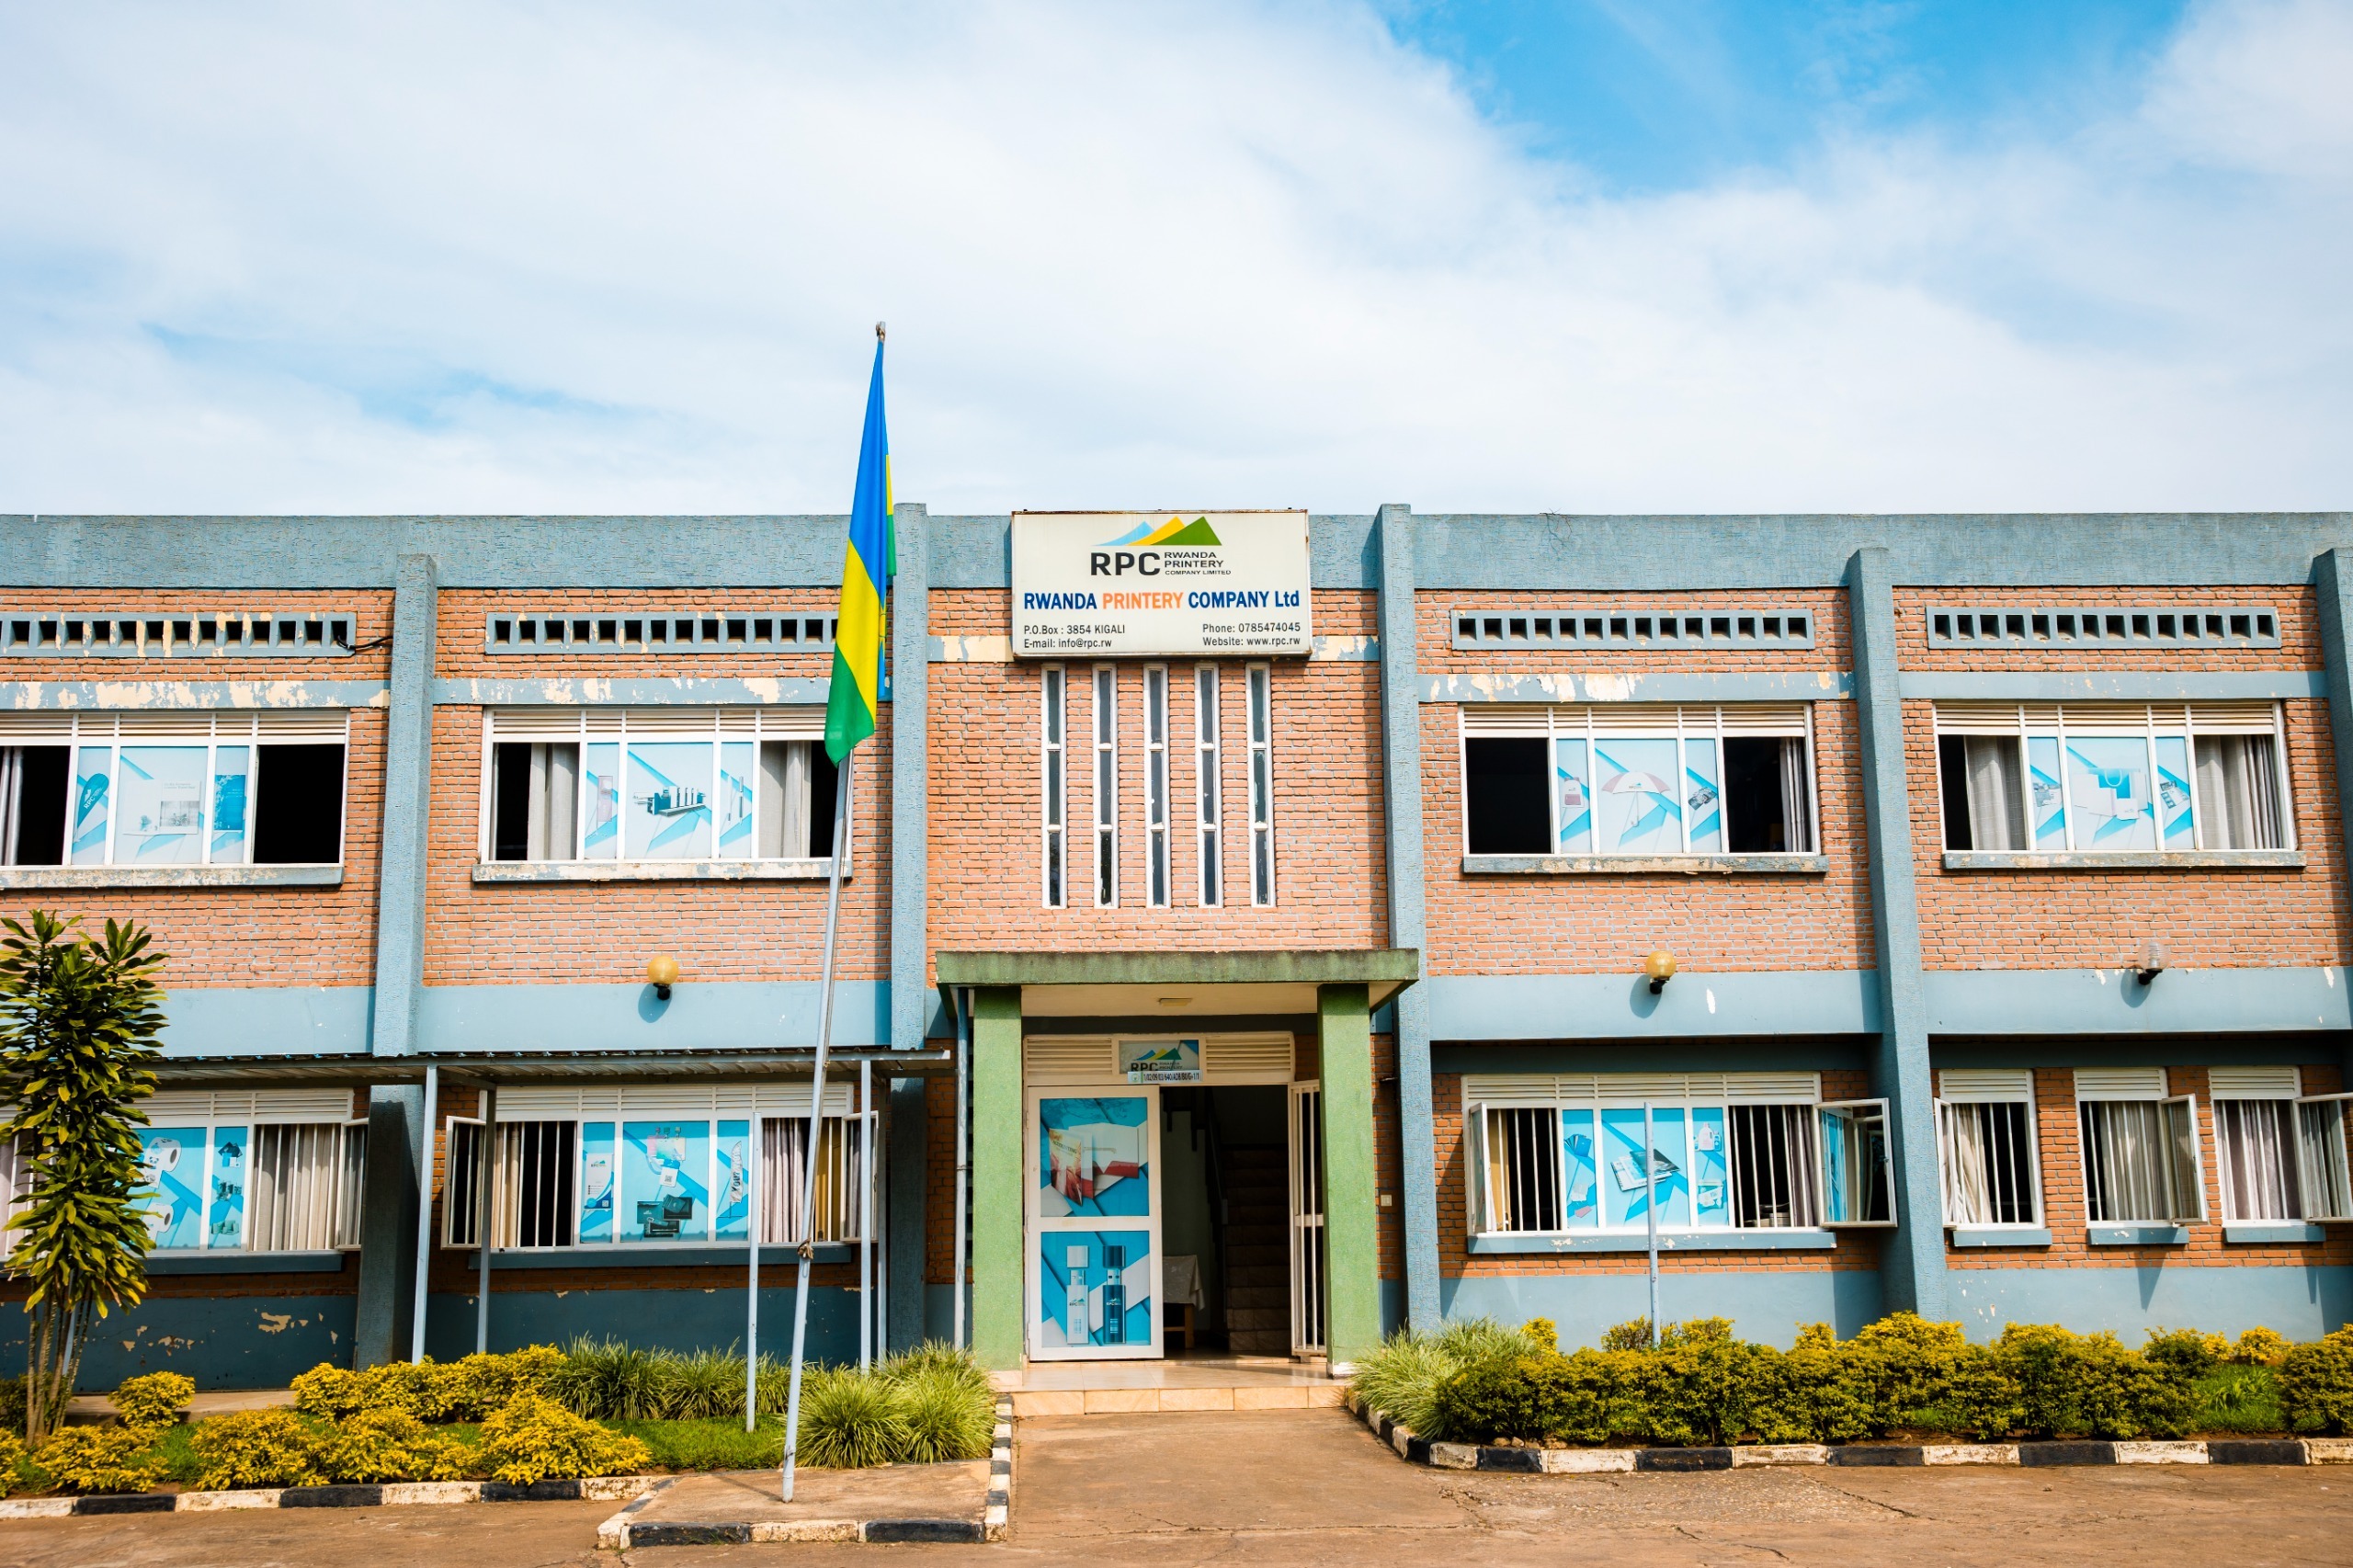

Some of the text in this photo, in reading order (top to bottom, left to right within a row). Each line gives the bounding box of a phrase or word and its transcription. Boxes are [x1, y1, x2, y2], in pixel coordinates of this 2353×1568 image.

[1090, 552, 1161, 575] RPC
[1164, 560, 1224, 568] PRINTERY
[1024, 590, 1300, 609] RWANDA PRINTERY COMPANY Ltd
[1066, 625, 1091, 634] 3854
[1095, 624, 1125, 634] KIGALI
[1202, 622, 1301, 633] Phone: 0785474045
[1024, 638, 1112, 649] E-mail: info@rpc.rw
[1202, 637, 1301, 647] Website: www.rpc.rw
[1131, 1062, 1159, 1071] RPC
